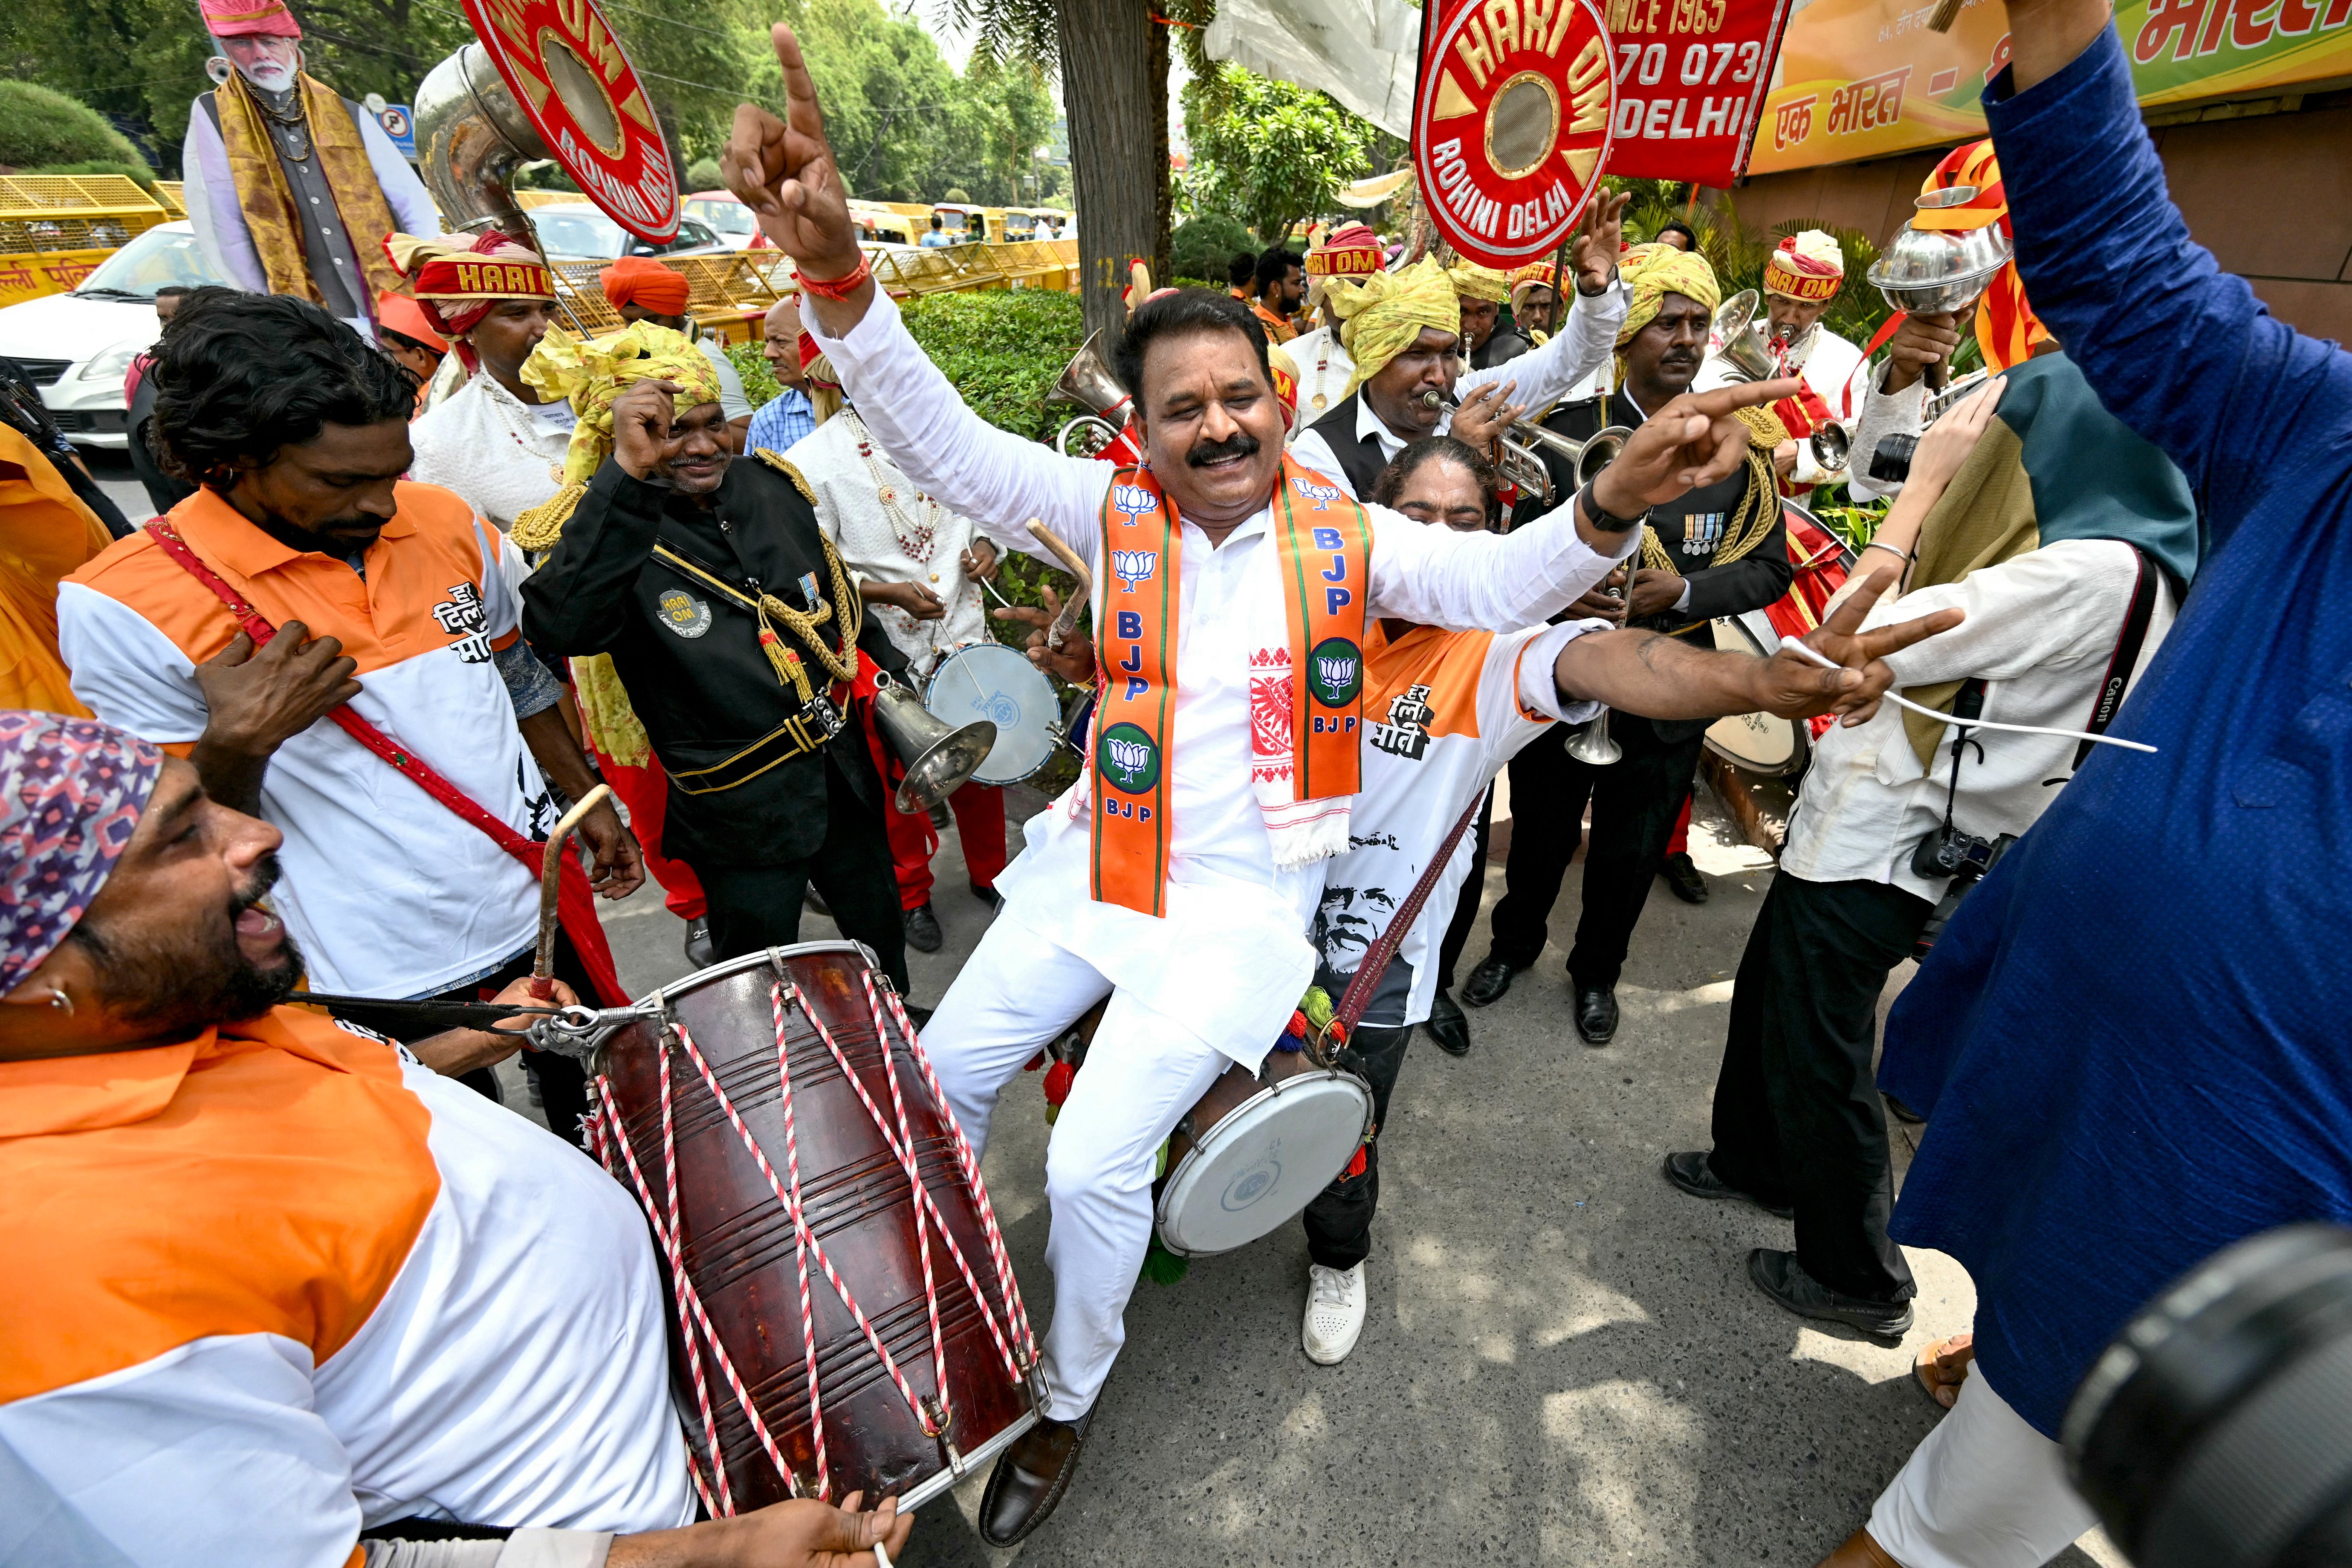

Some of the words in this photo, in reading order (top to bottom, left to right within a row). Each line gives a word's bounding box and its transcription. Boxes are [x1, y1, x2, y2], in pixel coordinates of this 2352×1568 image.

[1597, 0, 1661, 33] INCE
[1455, 0, 1576, 90] HARI
[1567, 35, 1609, 134] OM
[1681, 41, 1761, 86] 073
[1613, 96, 1745, 139] DELHI
[1774, 93, 1818, 152] एक
[1826, 64, 1913, 136] भारत
[560, 126, 658, 223] ROHINI
[637, 136, 671, 219] DELHI
[1432, 137, 1502, 238] ROHINI
[1507, 178, 1572, 239] DELHI
[457, 264, 536, 293] HARI
[1336, 251, 1375, 273] OM
[1766, 263, 1800, 294] HARI
[1801, 279, 1837, 297] OM
[1312, 527, 1351, 616] BJP
[448, 582, 474, 604] हर
[661, 594, 691, 612] HARI
[432, 600, 483, 633] दिल
[659, 614, 687, 636] LEGACY
[686, 620, 707, 636] SINCE
[699, 605, 710, 621] 1965
[672, 608, 696, 622] OM
[1117, 610, 1150, 702] BJP
[981, 689, 1001, 712] SPECIAL
[1407, 683, 1431, 702] हर
[2097, 677, 2122, 722] Canon
[1313, 716, 1357, 733] BJP
[1105, 797, 1151, 823] BJP
